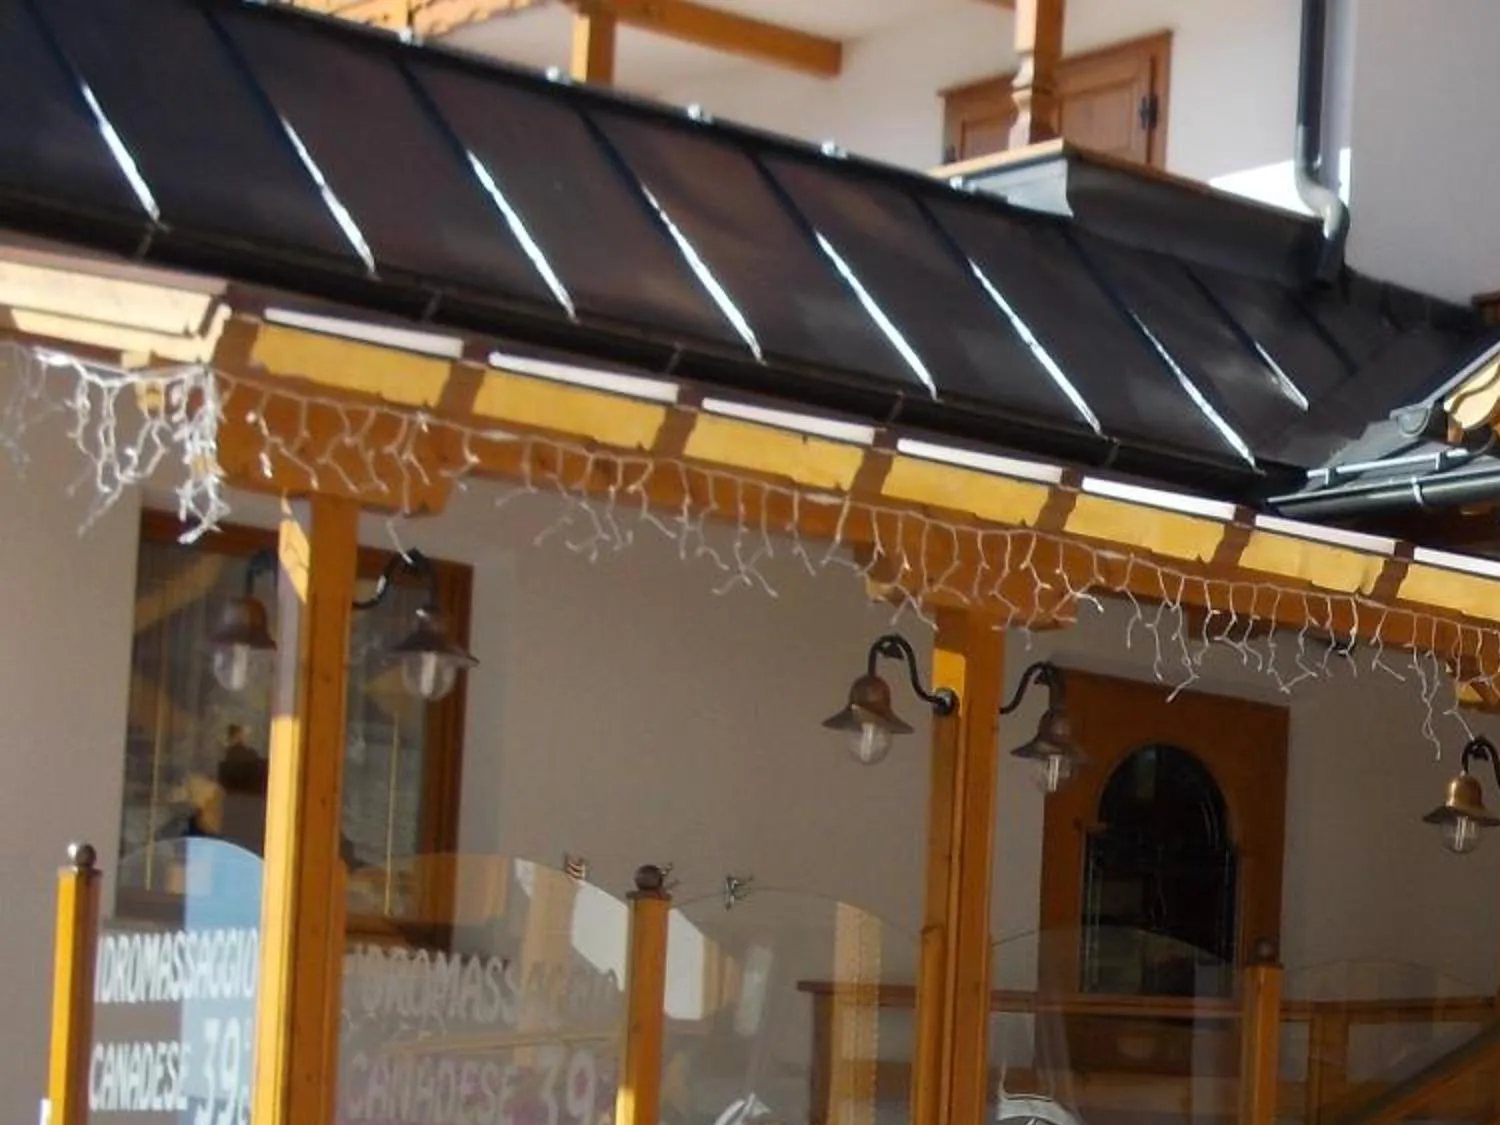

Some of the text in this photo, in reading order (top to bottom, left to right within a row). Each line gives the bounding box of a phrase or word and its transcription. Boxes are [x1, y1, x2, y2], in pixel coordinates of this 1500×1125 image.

[95, 927, 259, 1003] IDROMASSAGGIO
[346, 941, 620, 1030] IDROMASS
[88, 1040, 192, 1111] CANADESE
